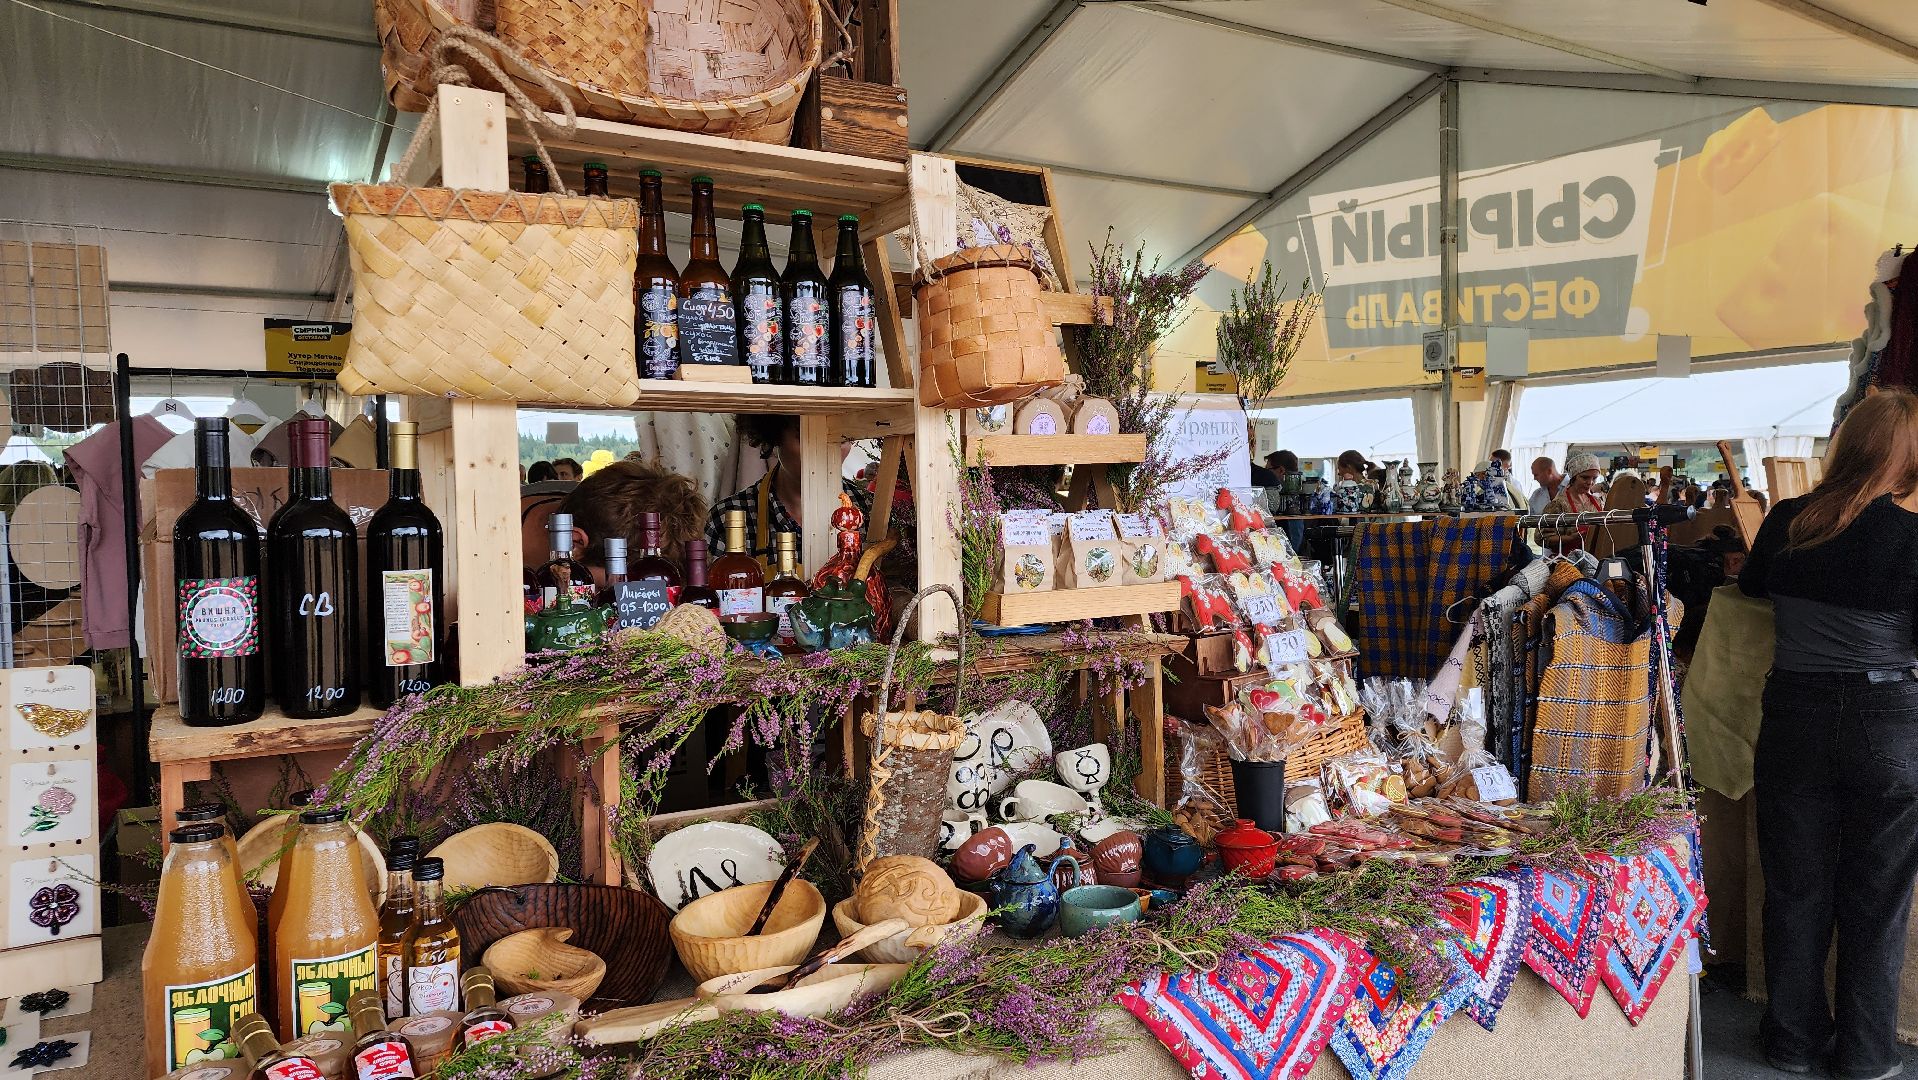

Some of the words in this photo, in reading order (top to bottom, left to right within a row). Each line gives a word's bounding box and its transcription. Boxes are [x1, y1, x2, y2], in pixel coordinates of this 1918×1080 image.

[708, 303, 735, 320] 450
[293, 326, 330, 334] СЫРНЫЙ
[287, 352, 312, 361] Хутор
[201, 606, 237, 616] ВИШНЯ
[1275, 635, 1299, 653] 150
[306, 685, 345, 702] 1200
[399, 679, 431, 692] 1200
[210, 686, 245, 706] 1200
[1479, 771, 1504, 787] 350
[418, 949, 447, 964] 250
[172, 970, 254, 1009] ЯБЛОЧНЫЙ
